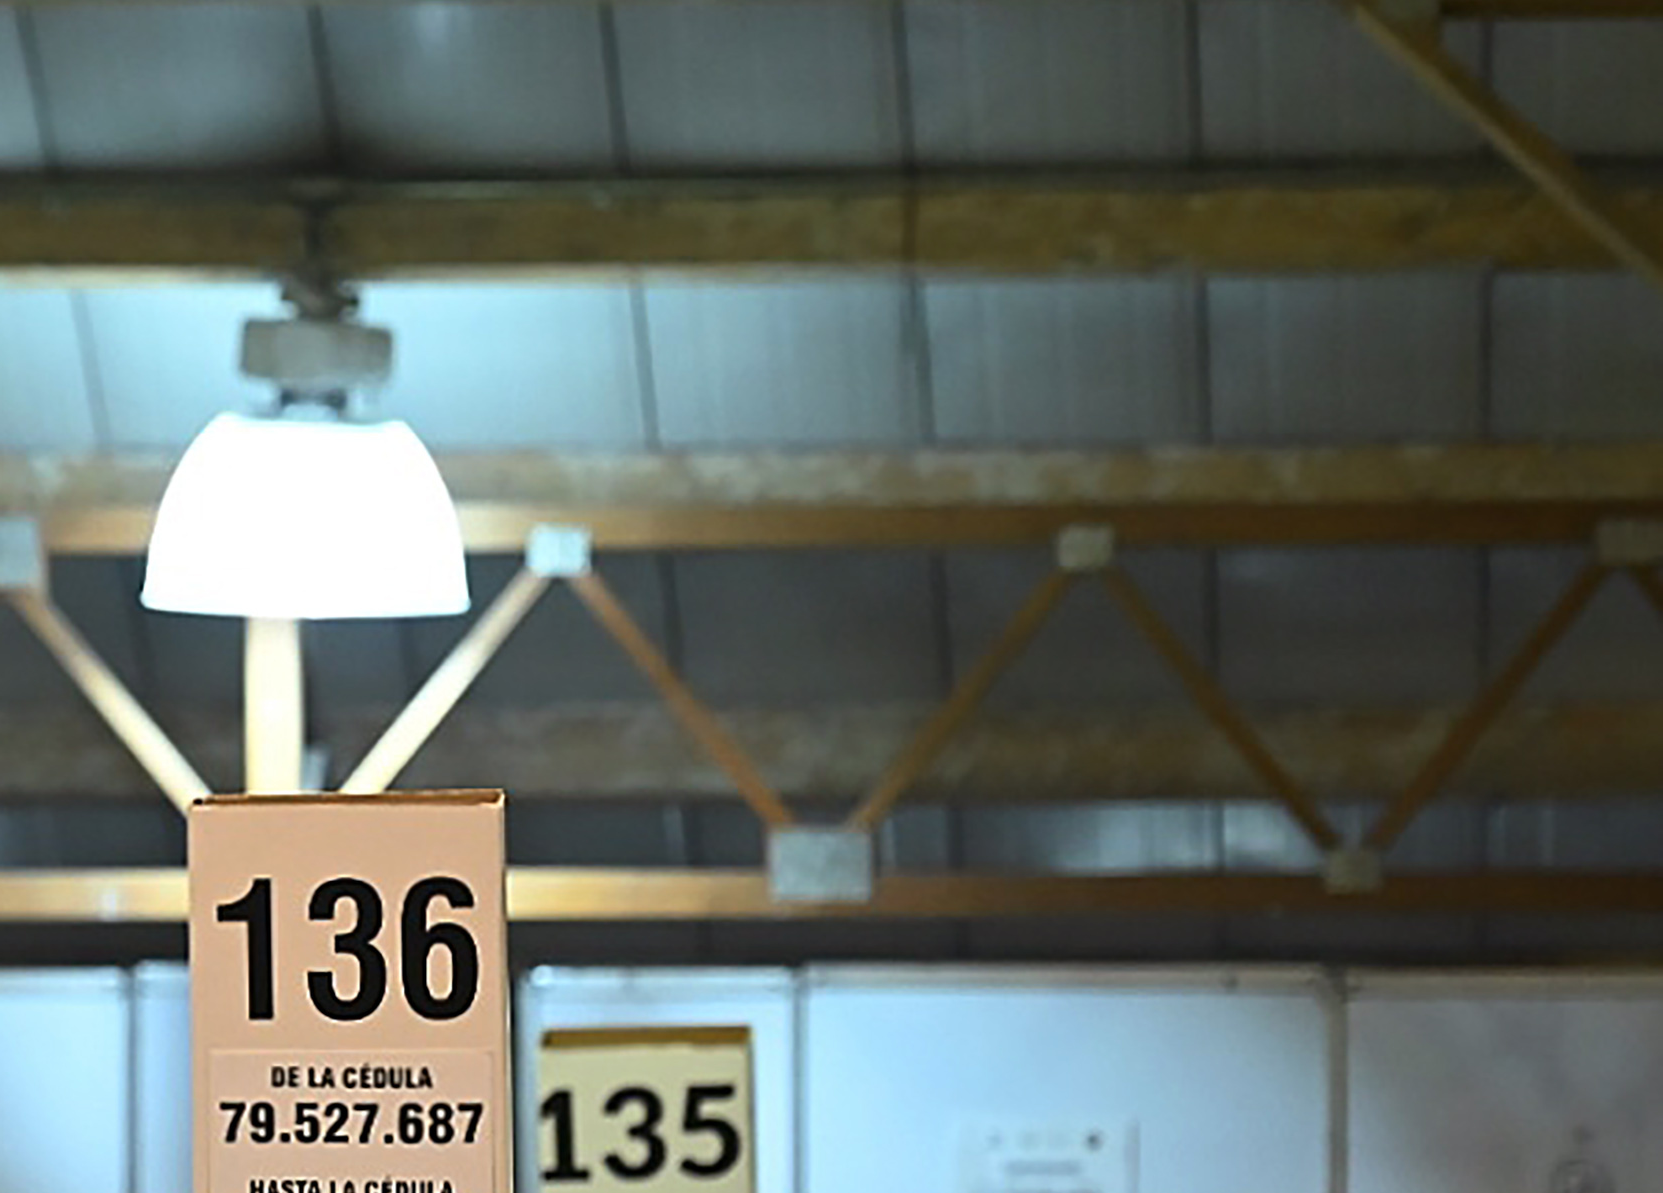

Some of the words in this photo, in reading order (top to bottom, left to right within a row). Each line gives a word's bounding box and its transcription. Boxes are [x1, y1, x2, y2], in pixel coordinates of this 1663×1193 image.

[216, 876, 479, 1022] 136
[270, 1066, 300, 1088] DE
[307, 1067, 336, 1088] LA
[342, 1062, 434, 1089] CÉDULA
[219, 1102, 484, 1145] 79.527.687
[540, 1084, 743, 1183] 135
